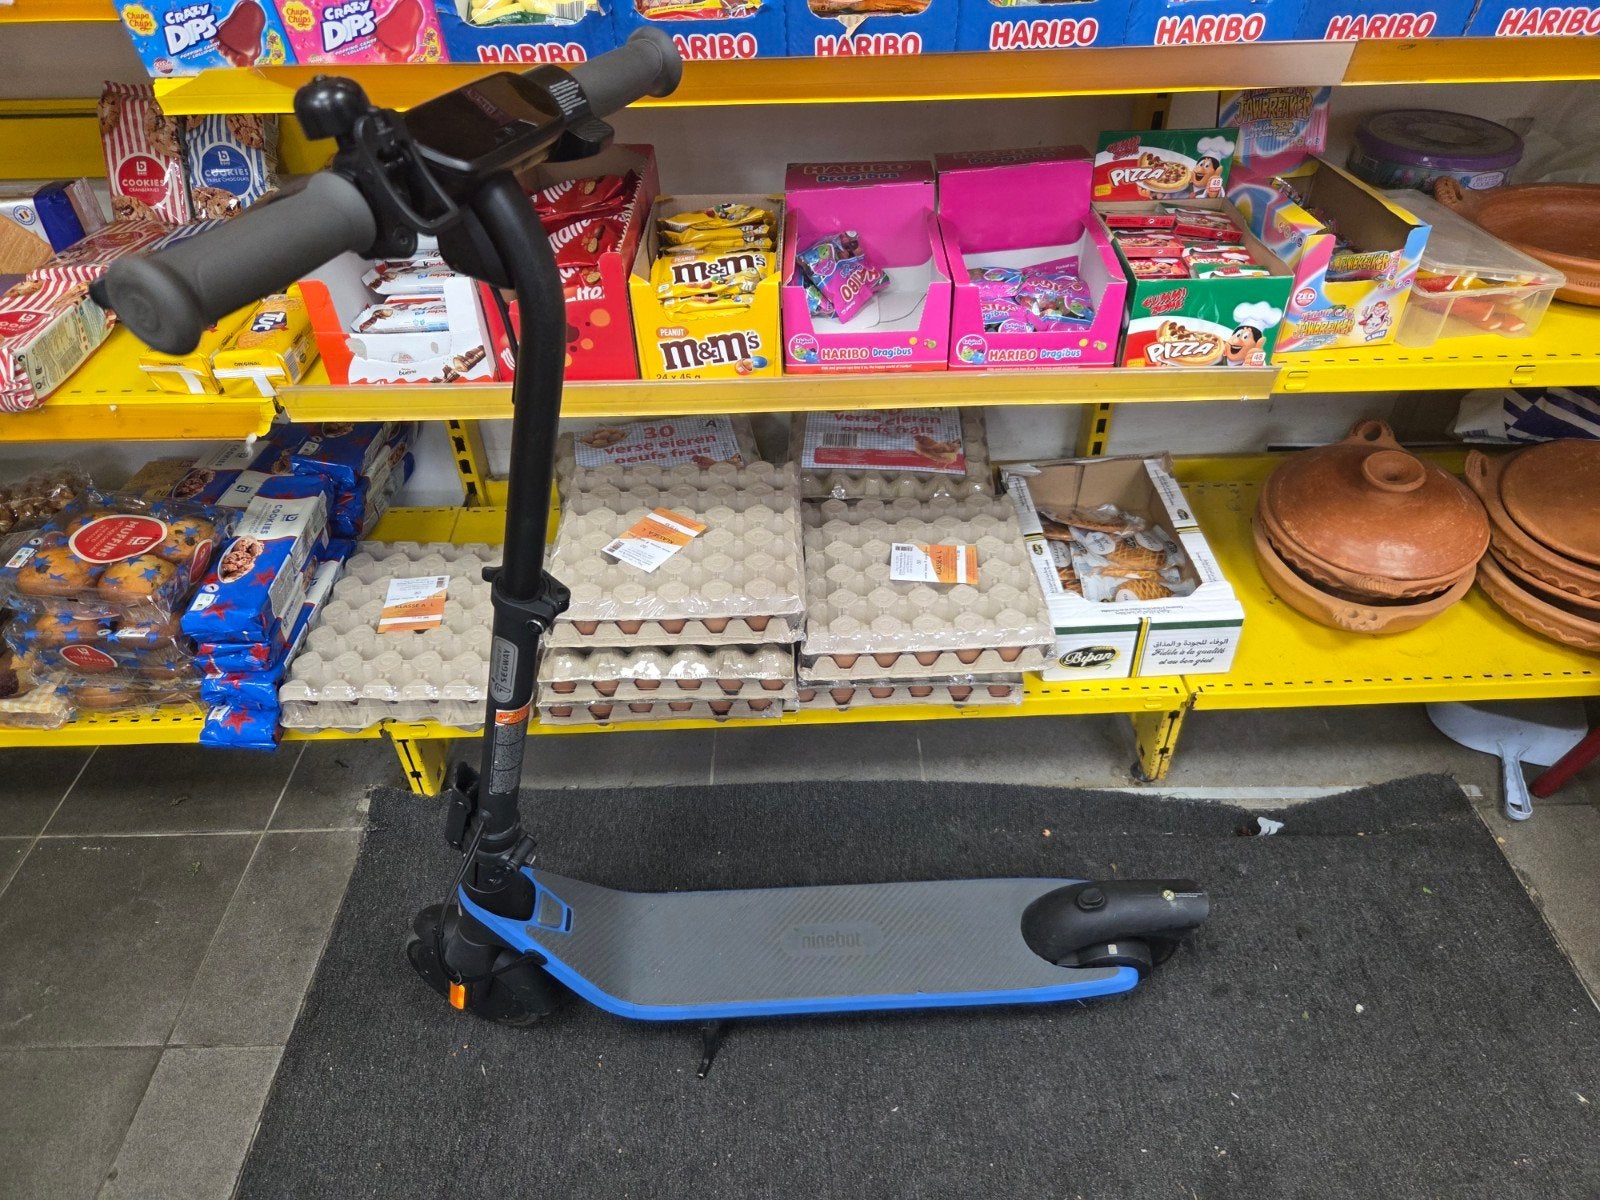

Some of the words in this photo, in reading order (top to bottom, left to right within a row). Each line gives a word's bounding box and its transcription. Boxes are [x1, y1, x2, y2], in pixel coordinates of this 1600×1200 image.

[126, 11, 150, 21] Chupa
[165, 3, 211, 25] CRAZY
[286, 8, 309, 18] Chupa
[325, 0, 369, 20] CRAZY
[129, 19, 153, 31] Chups
[288, 15, 312, 27] Chups
[1154, 13, 1266, 45] HARIBO
[1324, 12, 1437, 40] HARIBO
[1496, 7, 1600, 36] HARIBO
[164, 15, 217, 55] DIPS
[322, 11, 376, 52] DIPS
[989, 18, 1099, 49] HARIBO
[477, 43, 587, 63] HARIBO
[673, 33, 758, 60] ARIBO
[815, 32, 922, 57] HARIBO
[204, 168, 248, 178] COOKIES
[804, 164, 912, 175] HARIBO
[1110, 168, 1165, 187] PIZZA
[122, 178, 165, 187] COOKIES
[1212, 179, 1221, 187] 48
[660, 328, 684, 337] PEANUT
[821, 348, 869, 361] HARIBO
[873, 347, 913, 358] Dragibus
[989, 350, 1037, 361] HARIBO
[1040, 348, 1081, 360] Dragibus
[1147, 342, 1215, 363] PIZZA
[1253, 353, 1263, 361] 48
[398, 368, 417, 376] bueno
[834, 413, 882, 422] verse
[643, 425, 676, 438] 30
[604, 441, 654, 455] verse
[659, 434, 718, 449] eieren
[614, 451, 667, 464] oeufs
[671, 445, 712, 458] frais
[260, 504, 283, 535] COOKIES
[95, 520, 139, 558] MUFFINS
[500, 649, 512, 683] SEGWAY
